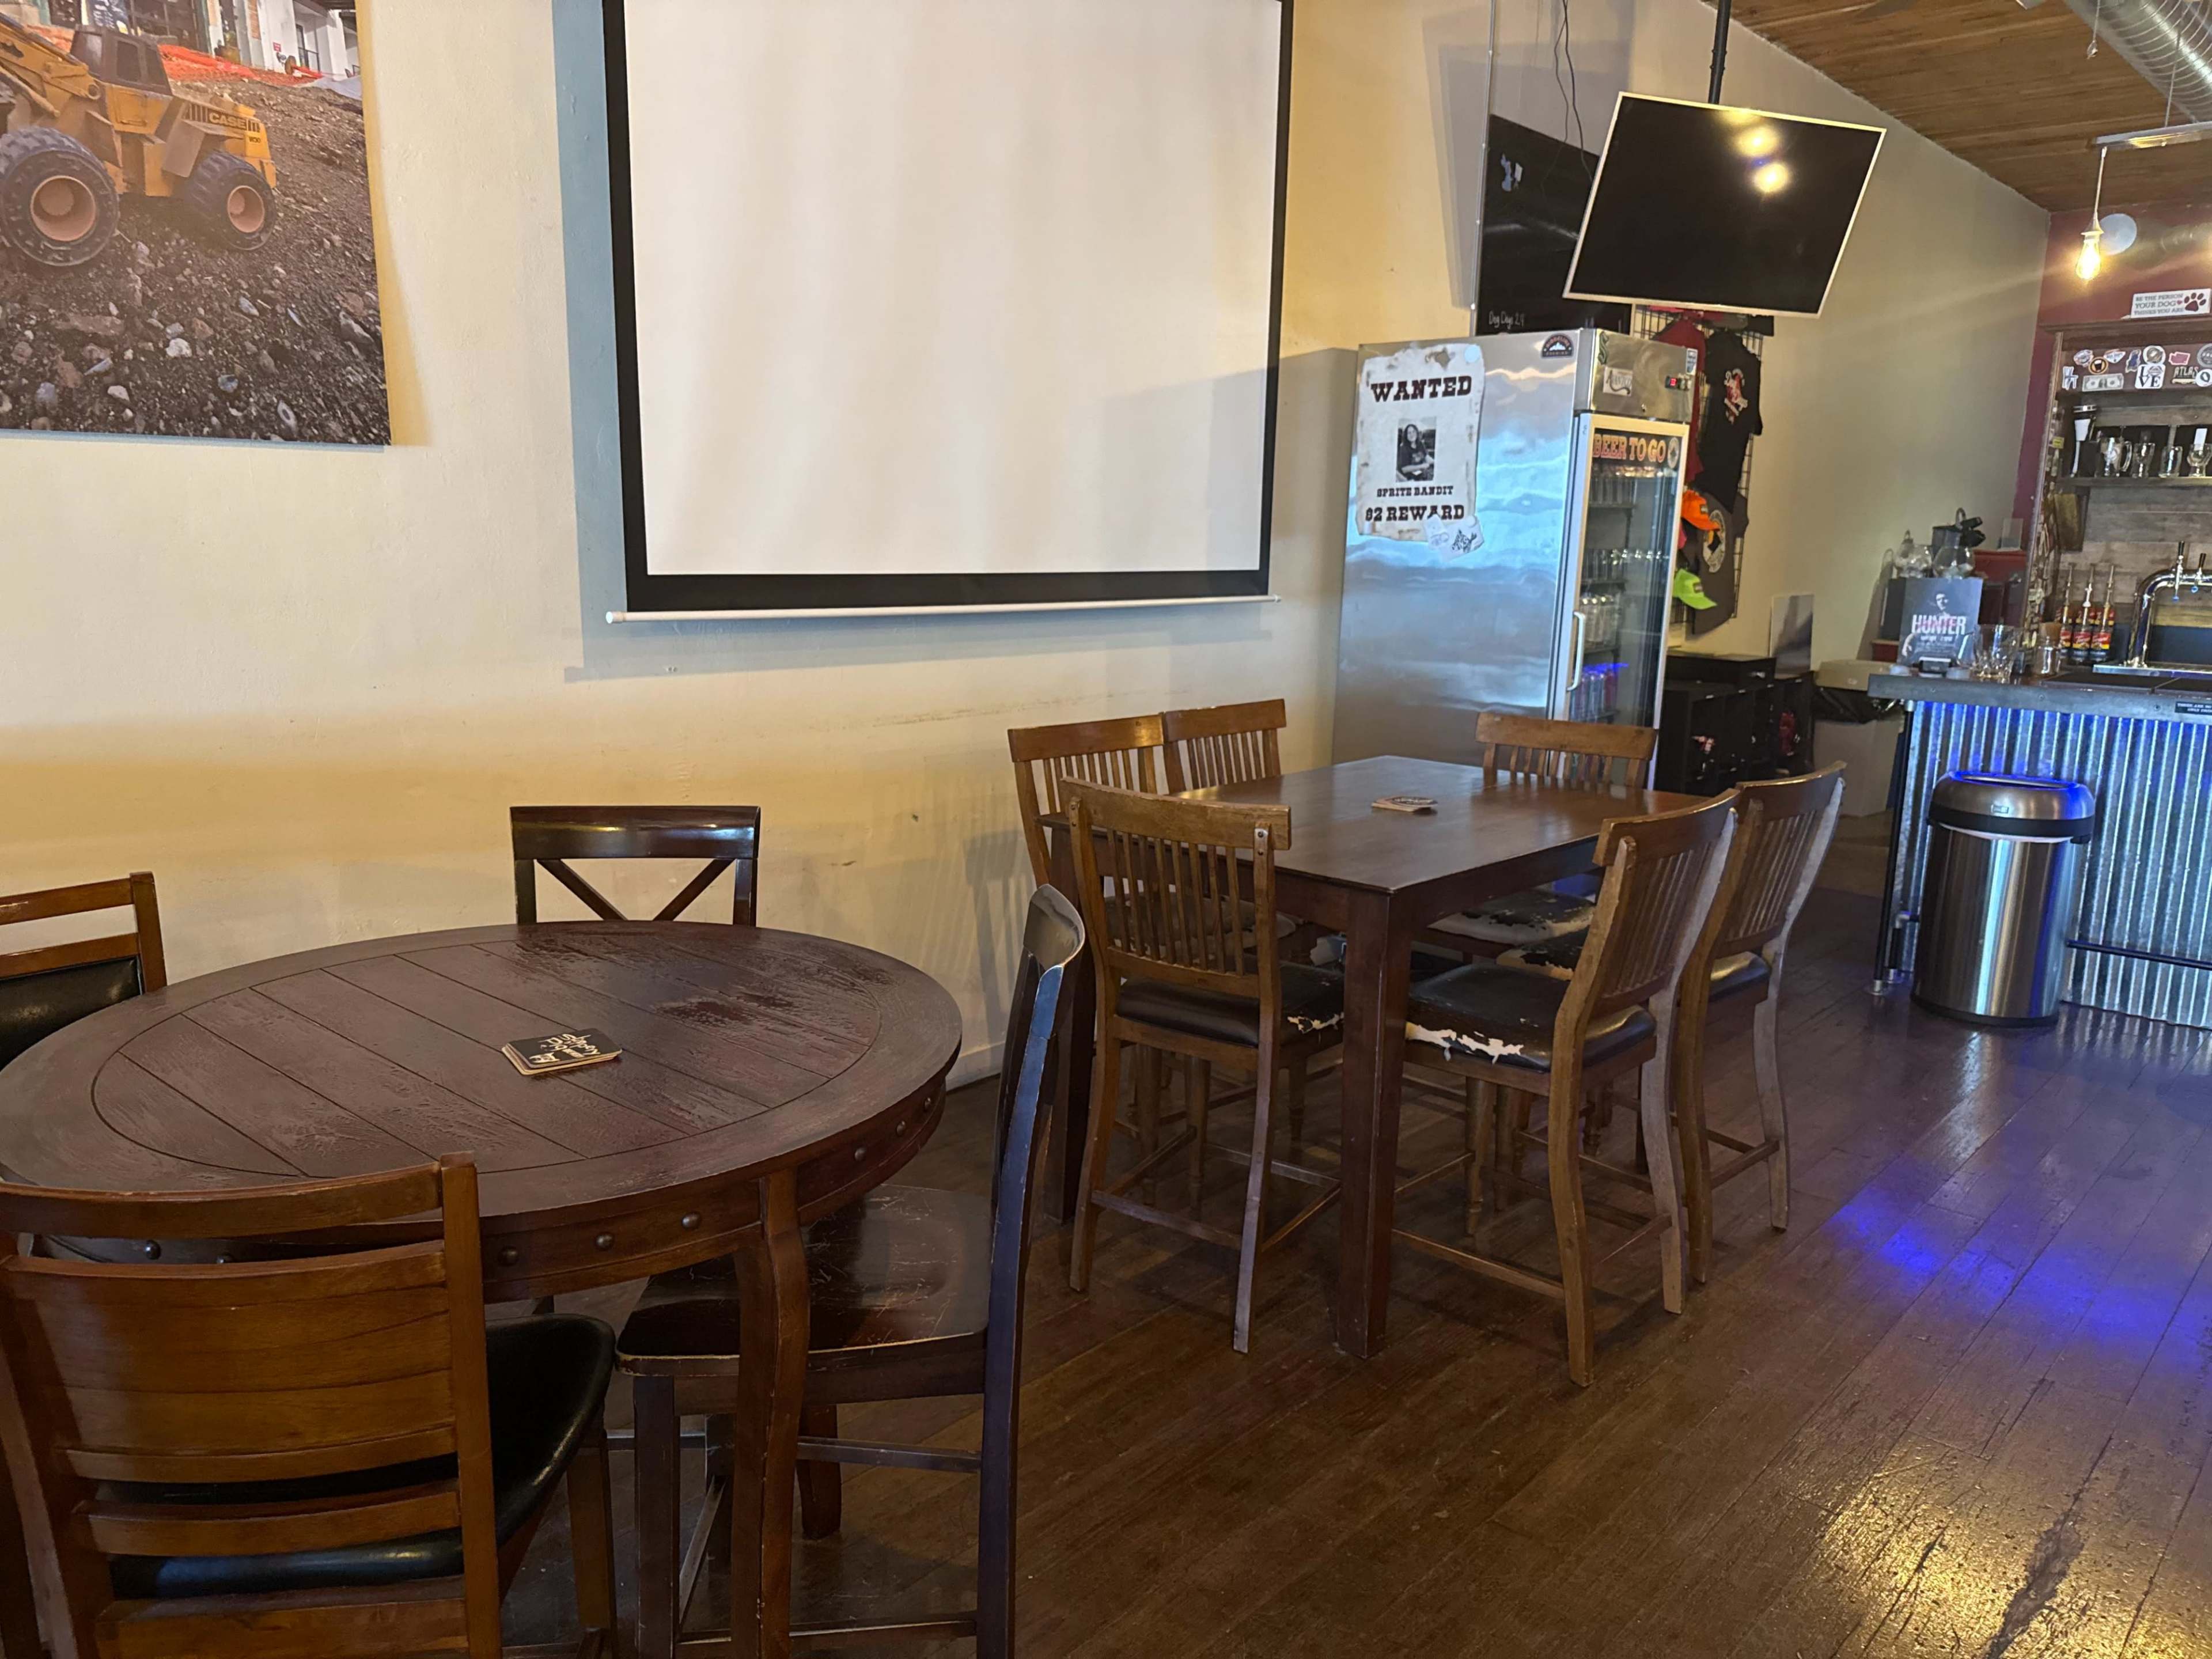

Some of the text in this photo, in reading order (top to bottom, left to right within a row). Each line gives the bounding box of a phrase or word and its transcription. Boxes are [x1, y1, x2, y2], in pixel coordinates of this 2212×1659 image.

[208, 112, 247, 129] CASE
[1488, 310, 1500, 328] Dog
[1370, 376, 1472, 403] WANTED
[1593, 433, 1666, 463] BEER TO GO
[1376, 486, 1453, 498] SPRITE BANDIT
[1386, 504, 1465, 522] REWARD
[1911, 614, 1968, 635] HUNTER
